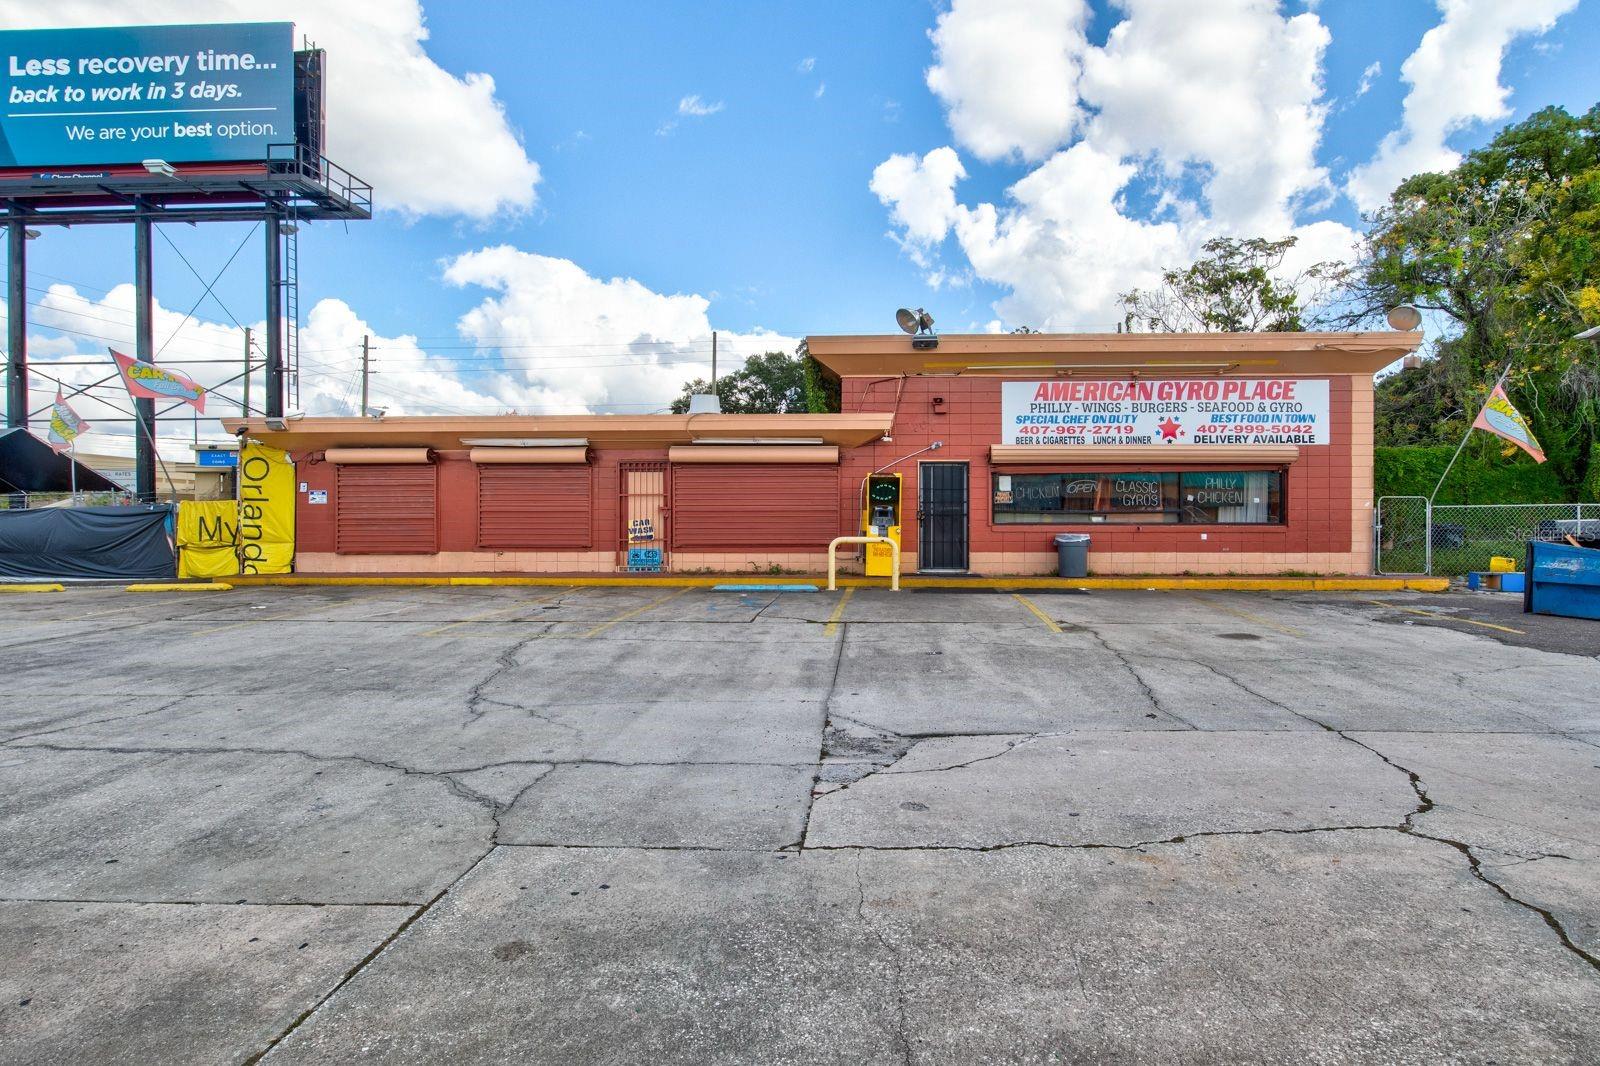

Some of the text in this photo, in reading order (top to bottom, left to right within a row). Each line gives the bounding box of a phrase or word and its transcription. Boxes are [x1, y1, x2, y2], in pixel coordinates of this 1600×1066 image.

[9, 49, 277, 77] Less recovery time...
[9, 81, 242, 103] back to work in 3 days.
[65, 121, 278, 142] We are your best option.
[127, 365, 163, 381] CAR
[1034, 381, 1297, 401] AMERICAN GYRO PLACE
[1030, 402, 1073, 413] PHILLY
[1082, 402, 1121, 413] WINGS
[1131, 402, 1187, 413] BURGERS
[1197, 402, 1254, 413] SEAFOOD
[1258, 402, 1267, 412] &
[1269, 402, 1303, 412] GYRO
[1015, 414, 1138, 424] SPECIAL CHEF ON DUTY
[1210, 414, 1316, 423] BEST FOOD IN TOWN
[1019, 425, 1134, 435] 407-967-2719
[1196, 425, 1313, 434] 407-999-5042
[1015, 436, 1085, 445] BEER & CIGARETTES
[1093, 436, 1151, 445] LUNCH & DINNER
[1194, 434, 1315, 444] DELIVERY AVAILABLE
[1066, 483, 1099, 494] OPEN
[1115, 480, 1158, 494] CLASSIC
[1204, 477, 1237, 490] PHILLY
[1122, 494, 1158, 506] GYROS
[1197, 491, 1243, 503] CHICKEN
[632, 519, 650, 527] CAR
[628, 526, 654, 535] WASH
